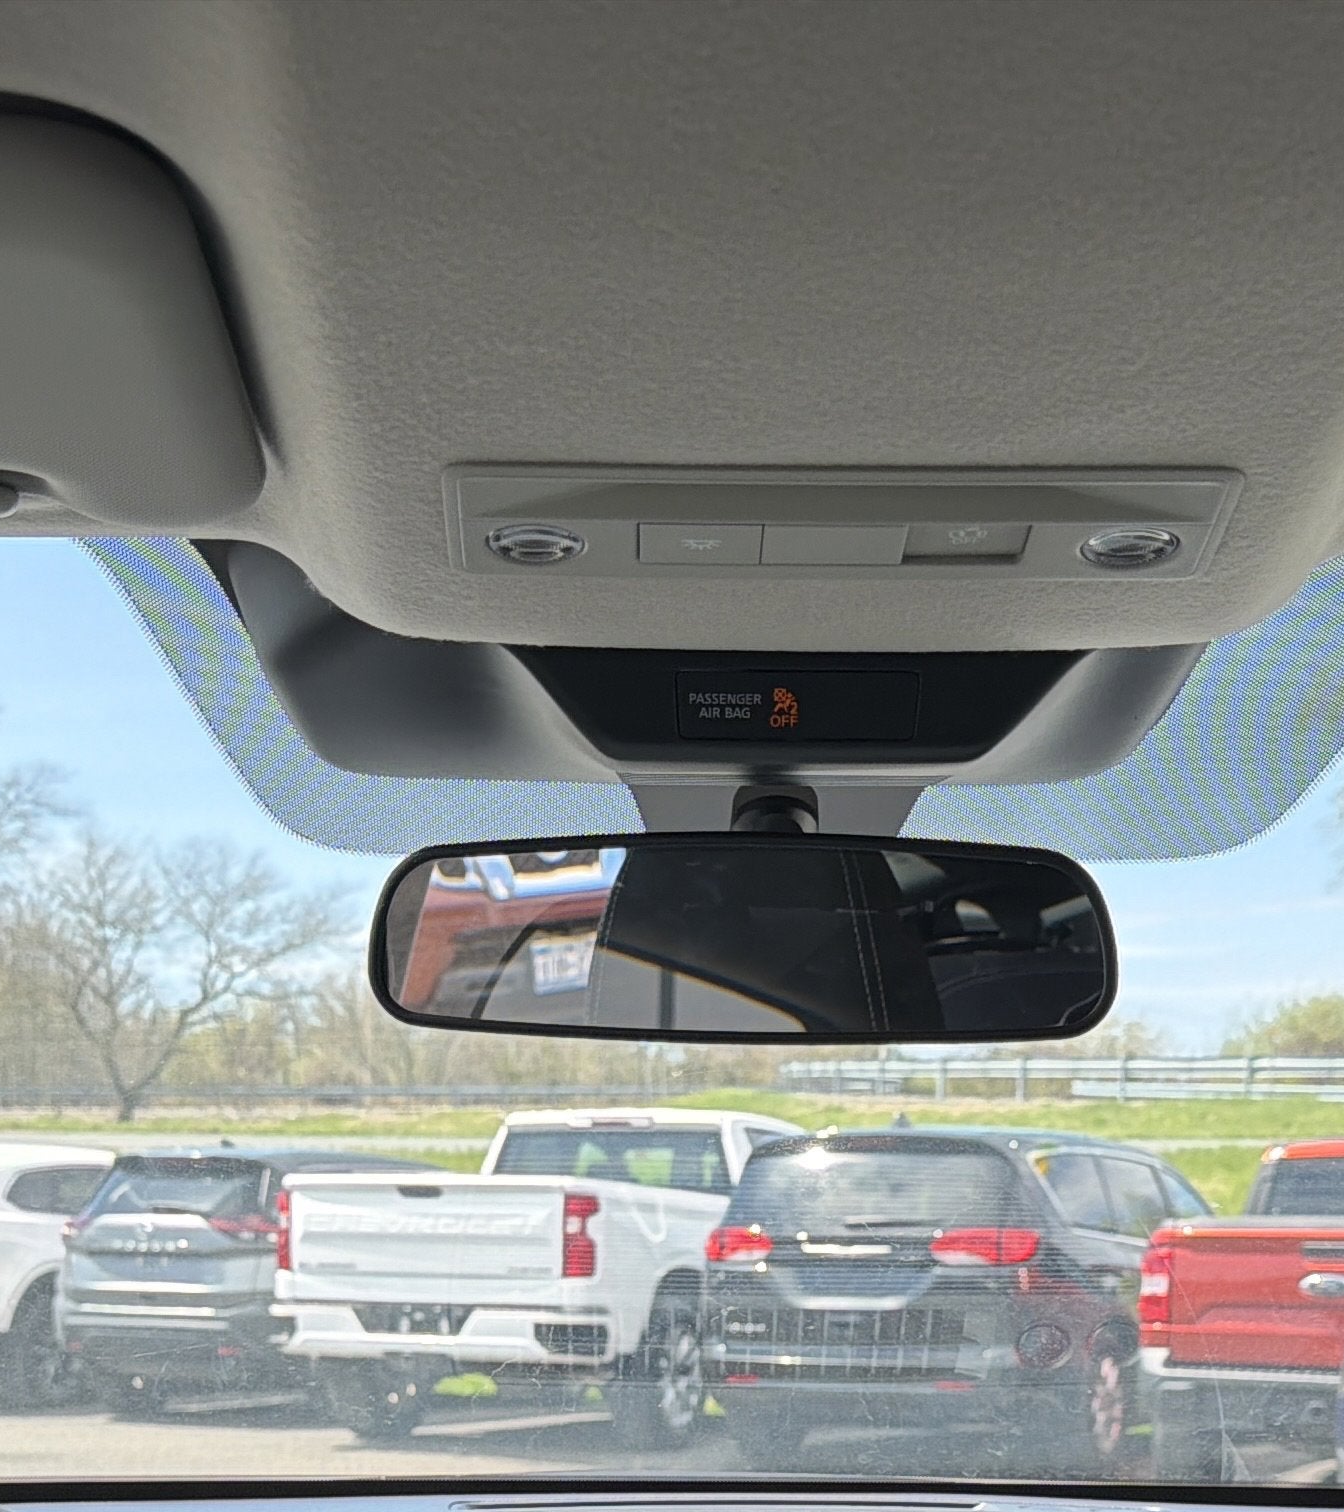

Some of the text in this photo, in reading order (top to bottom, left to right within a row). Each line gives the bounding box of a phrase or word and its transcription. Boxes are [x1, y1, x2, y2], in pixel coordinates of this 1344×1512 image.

[688, 693, 762, 705] PASSENGER
[698, 707, 751, 719] AIR BAG
[770, 715, 799, 728] OFF
